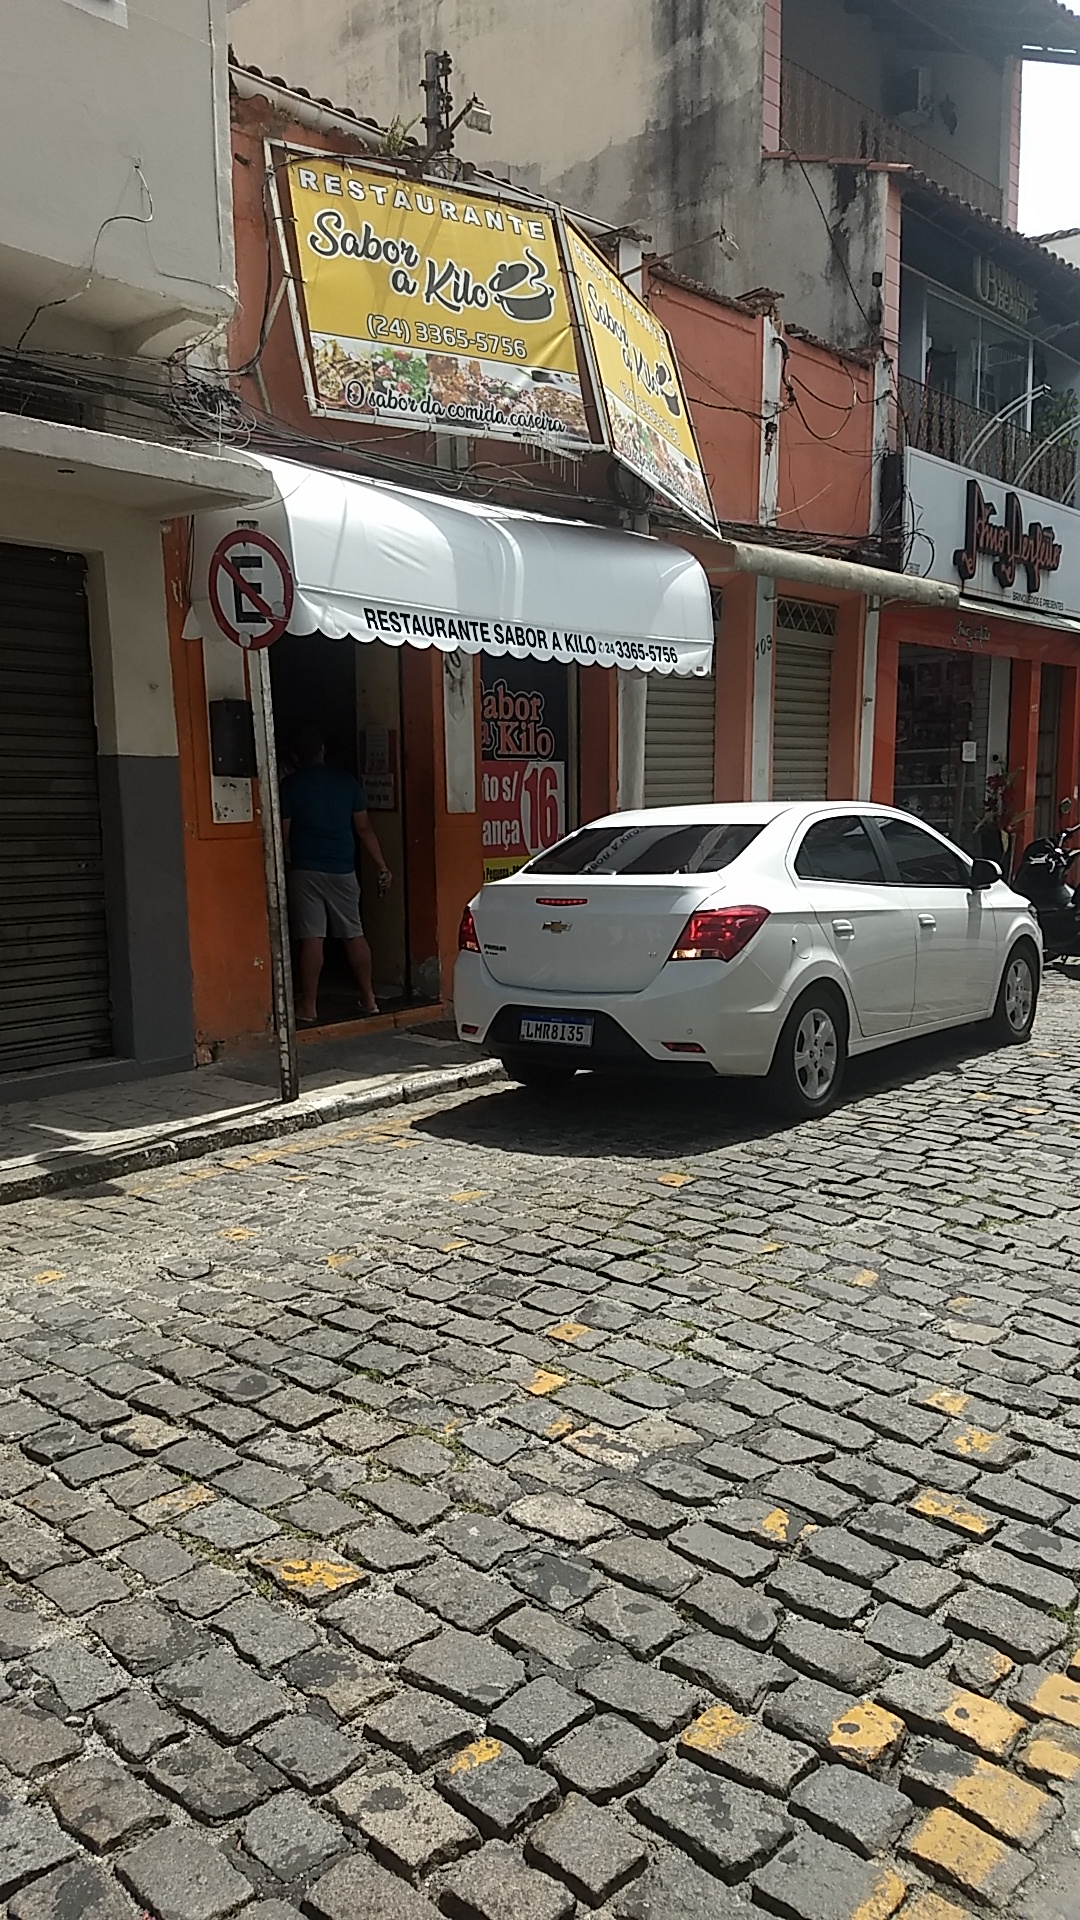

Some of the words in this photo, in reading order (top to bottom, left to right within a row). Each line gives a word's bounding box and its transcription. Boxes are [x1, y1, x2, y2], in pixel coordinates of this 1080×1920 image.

[298, 168, 546, 240] RESTAURANTE
[309, 210, 418, 267] Sabor
[391, 270, 418, 295] a
[424, 259, 489, 312] Kilo
[367, 313, 411, 343] (24)
[416, 321, 528, 360] 3365-5756
[587, 281, 629, 349] Sabor
[632, 343, 660, 397] Kilo
[346, 380, 366, 408] O
[368, 388, 418, 415] sabor
[419, 394, 446, 418] da
[447, 402, 508, 425] comida
[509, 413, 566, 433] caseira
[231, 556, 266, 623] E
[363, 607, 492, 643] RESTAURANTE
[493, 623, 549, 650] SABOR
[552, 631, 562, 651] A
[564, 632, 597, 655] KILO
[605, 642, 615, 654] 24
[615, 640, 678, 664] 3365-5756
[756, 634, 772, 660] 109
[481, 684, 543, 721] abor
[498, 721, 552, 756] Kilo
[481, 773, 499, 802] to
[523, 766, 559, 850] 16
